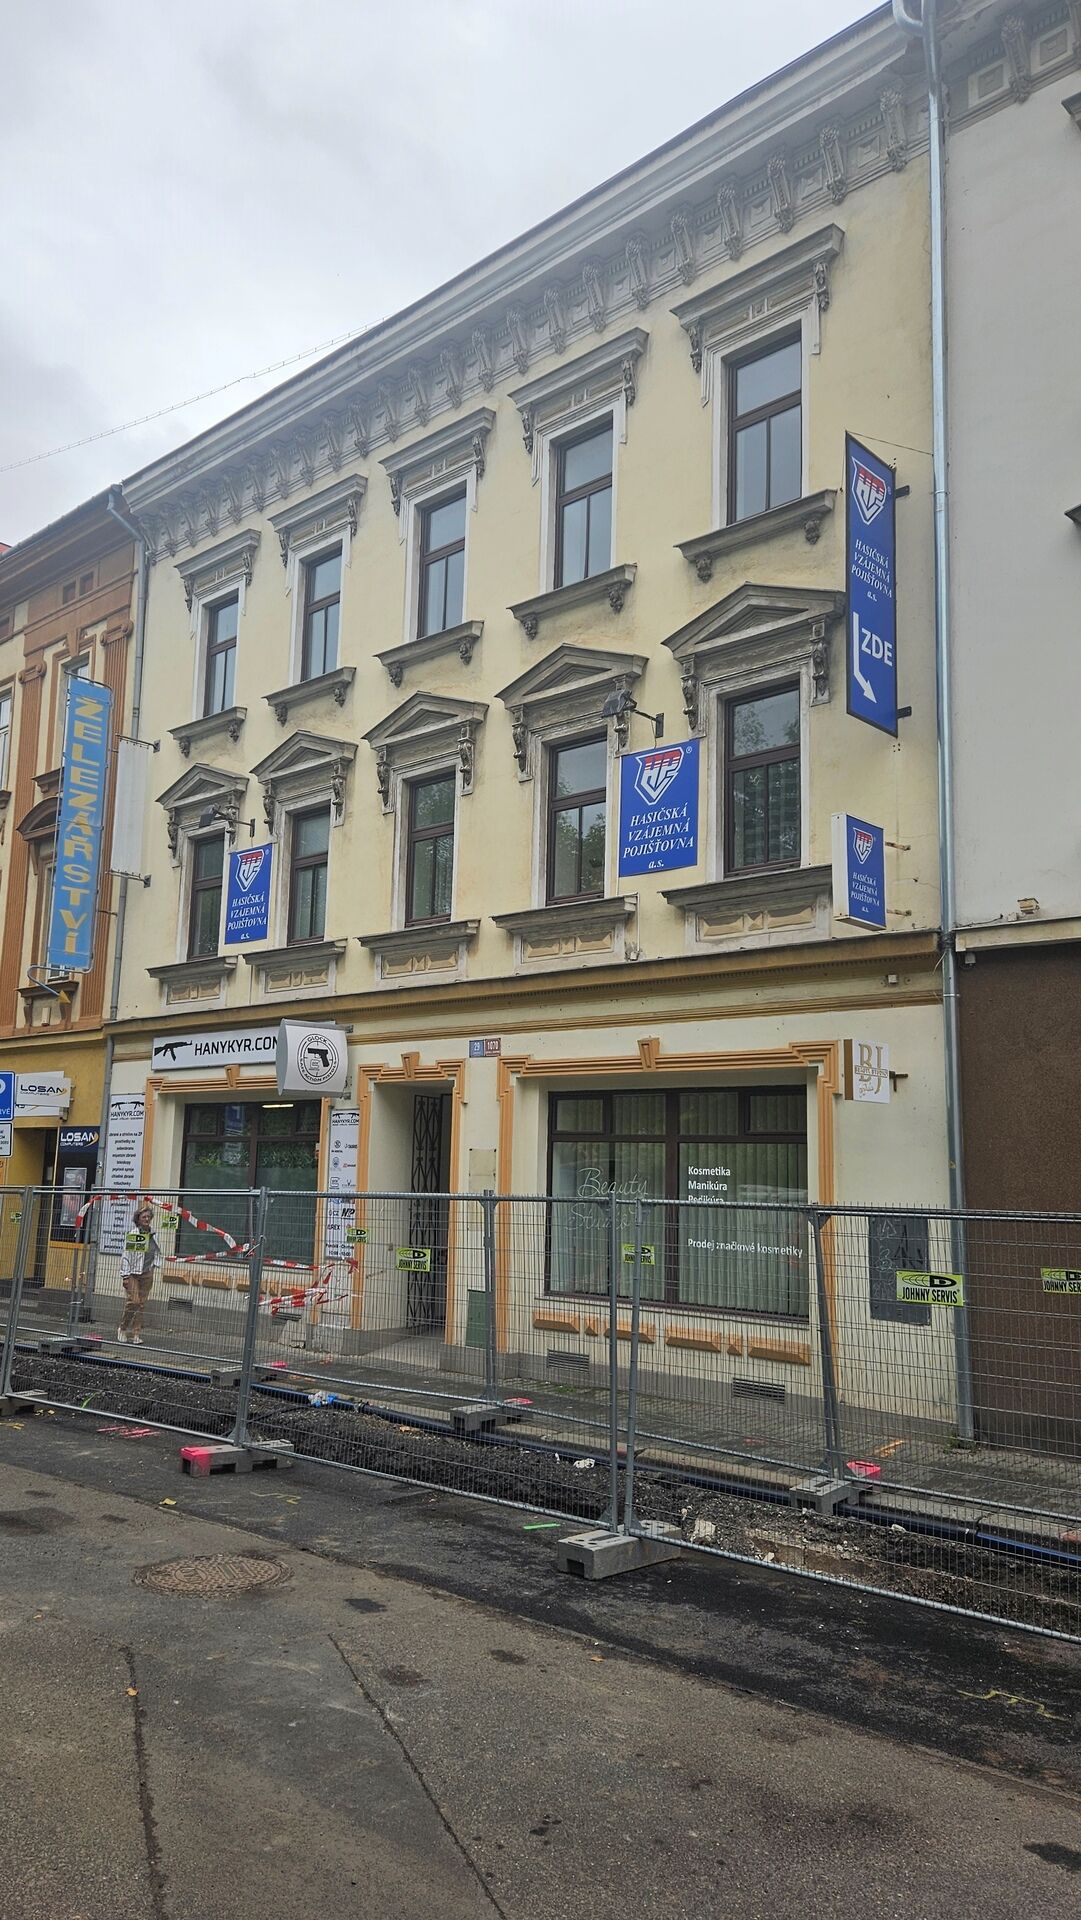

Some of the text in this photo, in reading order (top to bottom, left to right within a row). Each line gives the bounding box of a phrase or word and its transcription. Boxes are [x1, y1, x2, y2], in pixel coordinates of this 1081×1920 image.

[855, 539, 889, 568] HASIČSKÁ
[854, 552, 890, 583] VZÁJEMNÁ
[851, 564, 892, 598] POJIŠŤOVNA
[867, 591, 877, 602] a.s.
[861, 627, 892, 667] ZDE
[630, 802, 688, 827] HASIČSKÁ
[628, 817, 690, 842] VZÁJEMNÁ
[623, 836, 694, 858] POJIŠŤOVNA
[648, 860, 664, 869] a.s.
[232, 891, 265, 908] HASIČSKÁ
[230, 903, 266, 919] VZÁJEMNÁ
[227, 916, 267, 931] POJIŠŤOVNA
[307, 1035, 327, 1043] GLOCK
[20, 1084, 64, 1094] LOSAN
[61, 1132, 96, 1142] LOSAN
[688, 1165, 731, 1176] Kosmetika
[577, 1167, 650, 1202] Beauty
[688, 1180, 728, 1191] Manikúra
[688, 1238, 715, 1251] Prodej
[757, 1242, 803, 1258] kosmetiky
[902, 1287, 958, 1304] JOHNNY SERVIS
